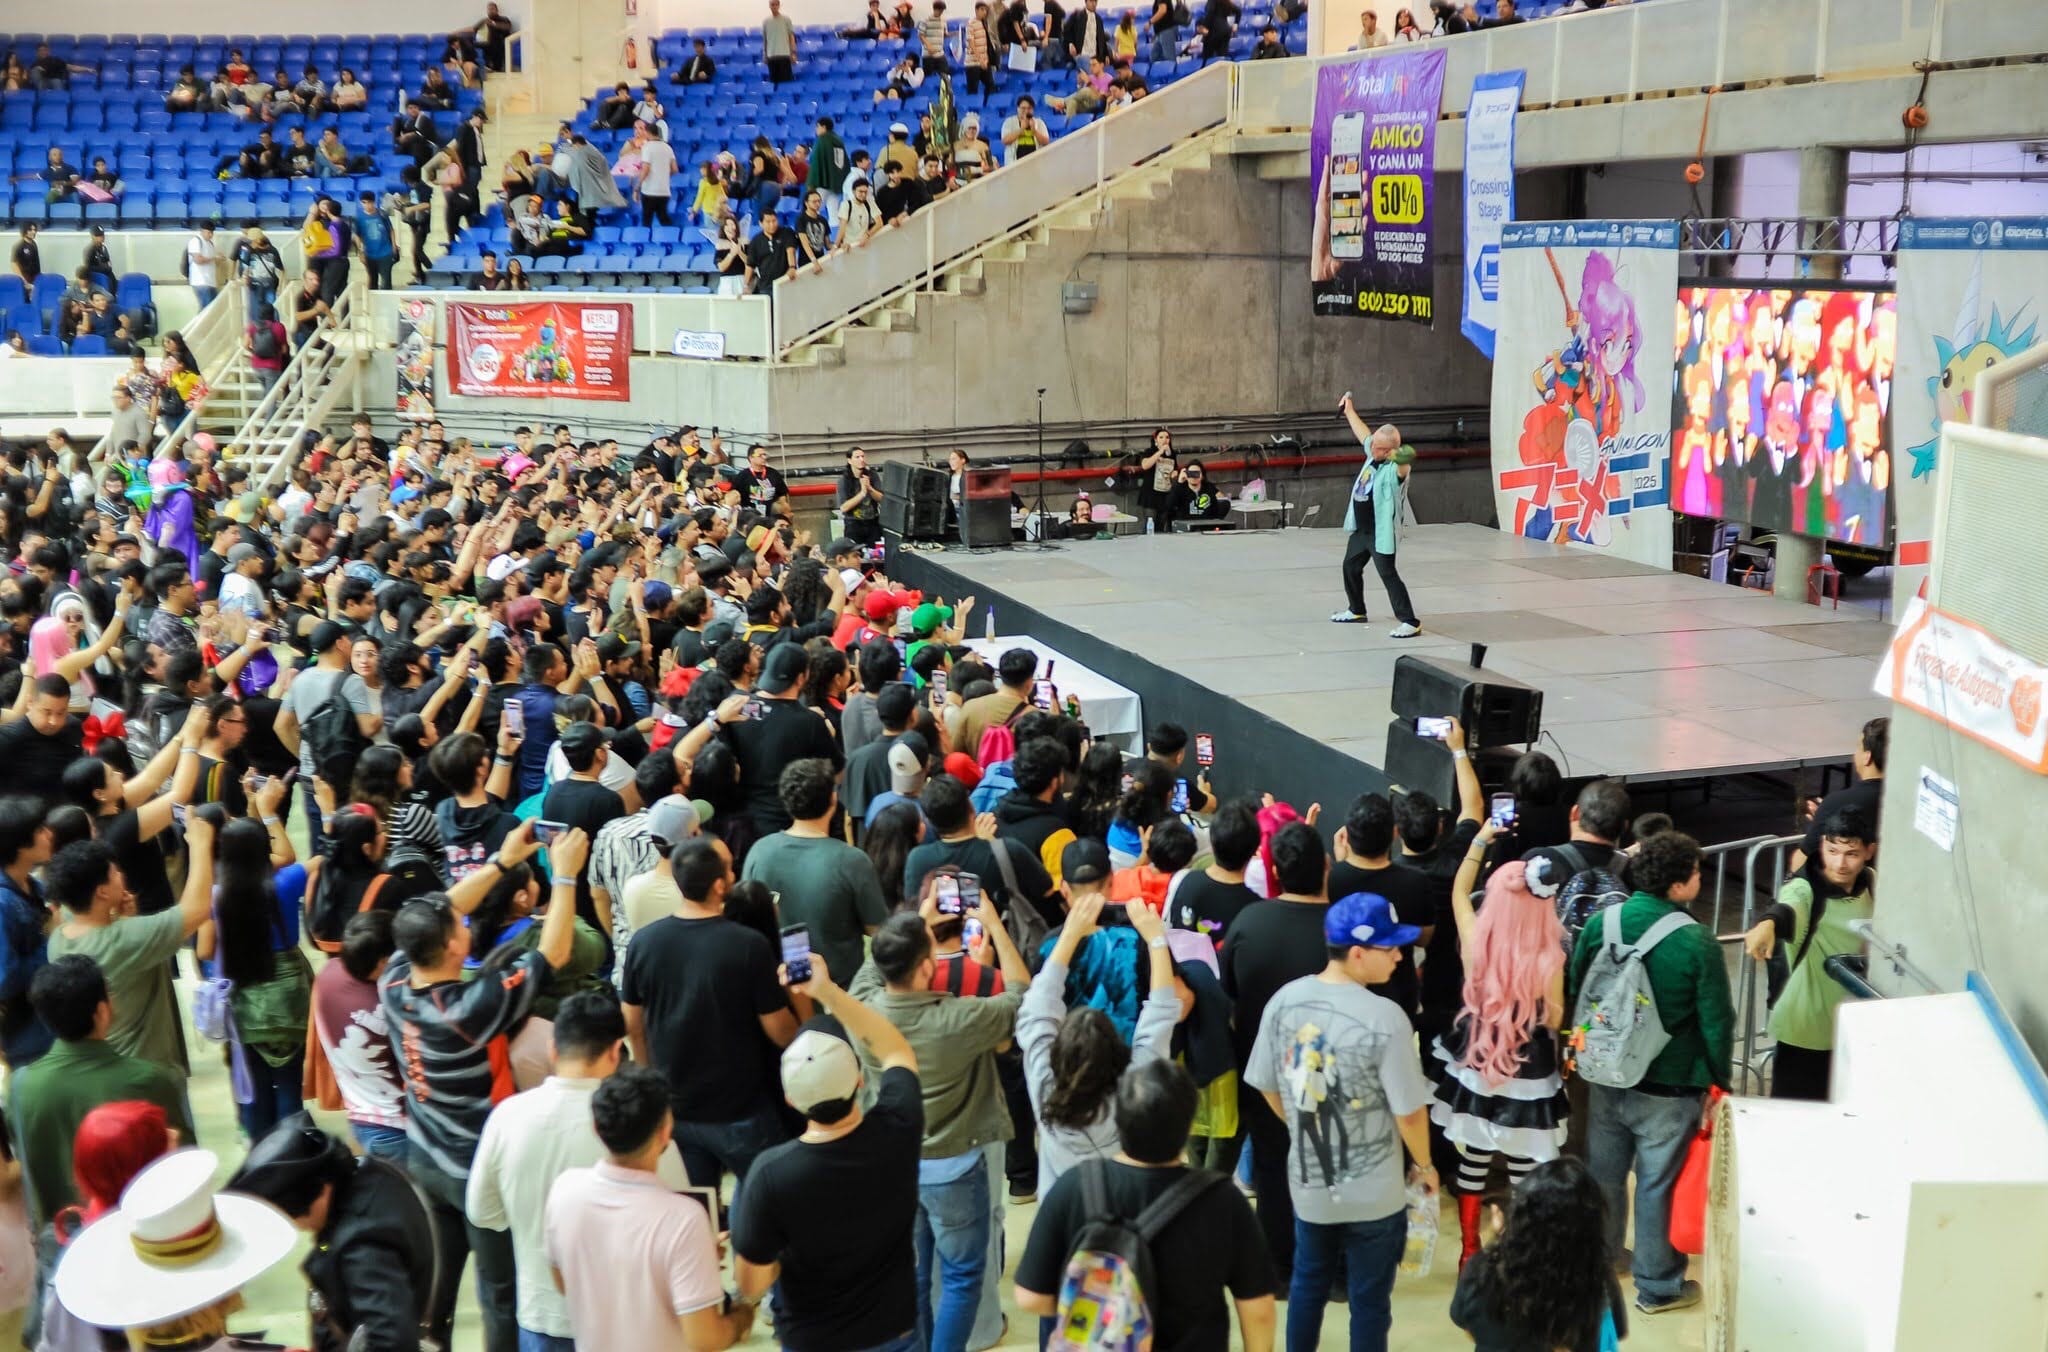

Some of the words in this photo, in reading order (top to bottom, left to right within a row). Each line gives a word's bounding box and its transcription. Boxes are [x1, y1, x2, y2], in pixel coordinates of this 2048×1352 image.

[1370, 123, 1424, 150] AMIGO
[1370, 154, 1377, 170] Y
[1378, 153, 1406, 170] GANA
[1408, 152, 1424, 169] UN
[1470, 178, 1511, 198] Crossing
[1380, 181, 1418, 217] 50%
[1478, 201, 1503, 221] Stage
[586, 313, 613, 325] NETFLIX
